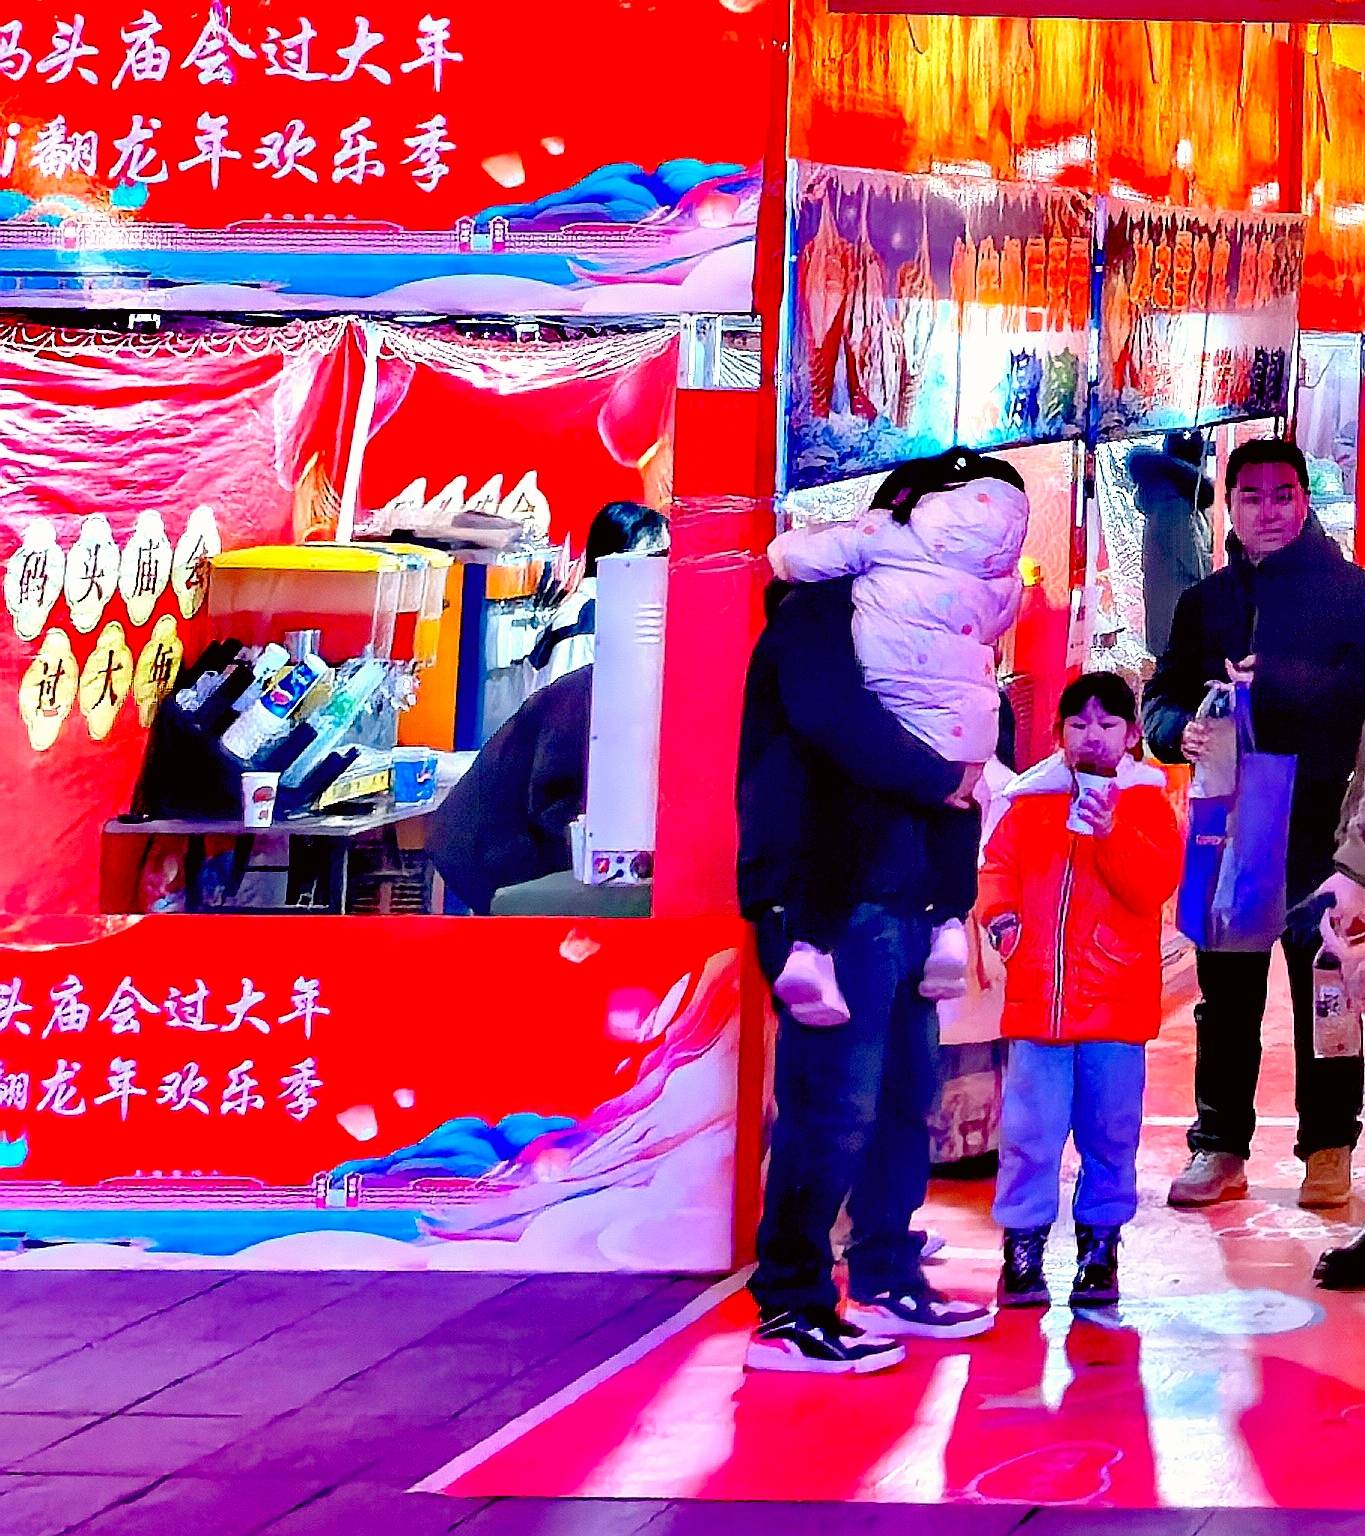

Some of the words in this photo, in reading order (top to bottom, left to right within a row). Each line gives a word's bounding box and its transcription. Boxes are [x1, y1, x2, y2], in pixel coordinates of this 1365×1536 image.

[0, 974, 331, 1041] 头庙会过大年
